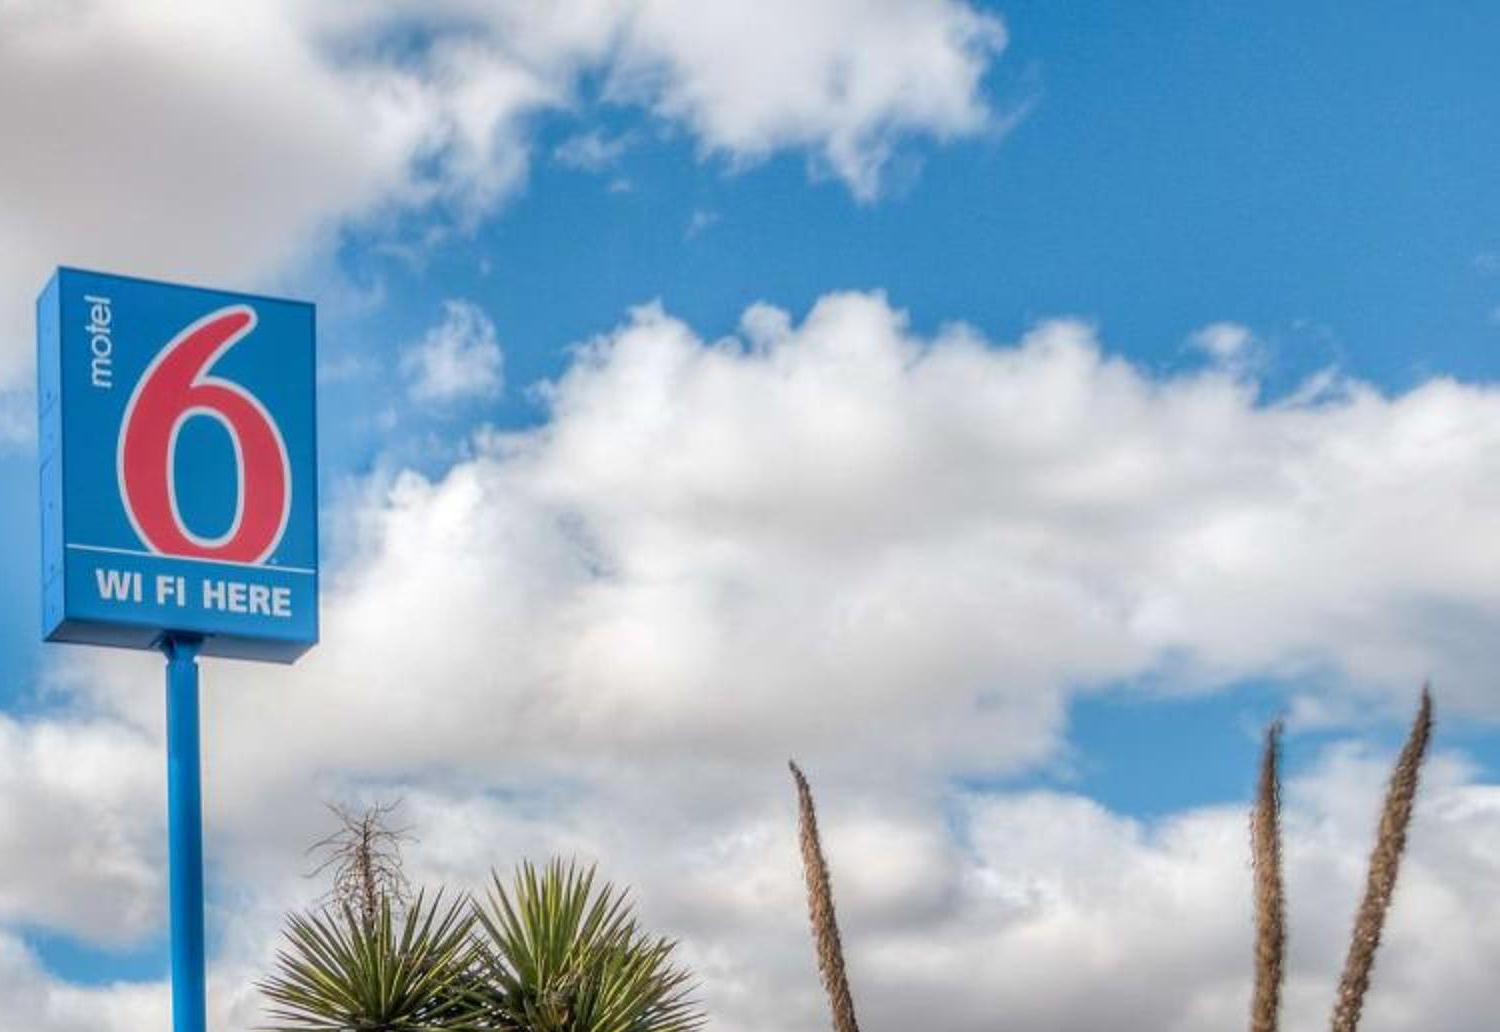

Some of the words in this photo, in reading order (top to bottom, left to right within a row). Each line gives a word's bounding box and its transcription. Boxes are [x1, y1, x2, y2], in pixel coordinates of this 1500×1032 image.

[84, 294, 113, 388] motel
[116, 303, 293, 566] 6
[95, 568, 143, 604] WI
[156, 575, 186, 608] FI
[203, 579, 292, 617] HERE
